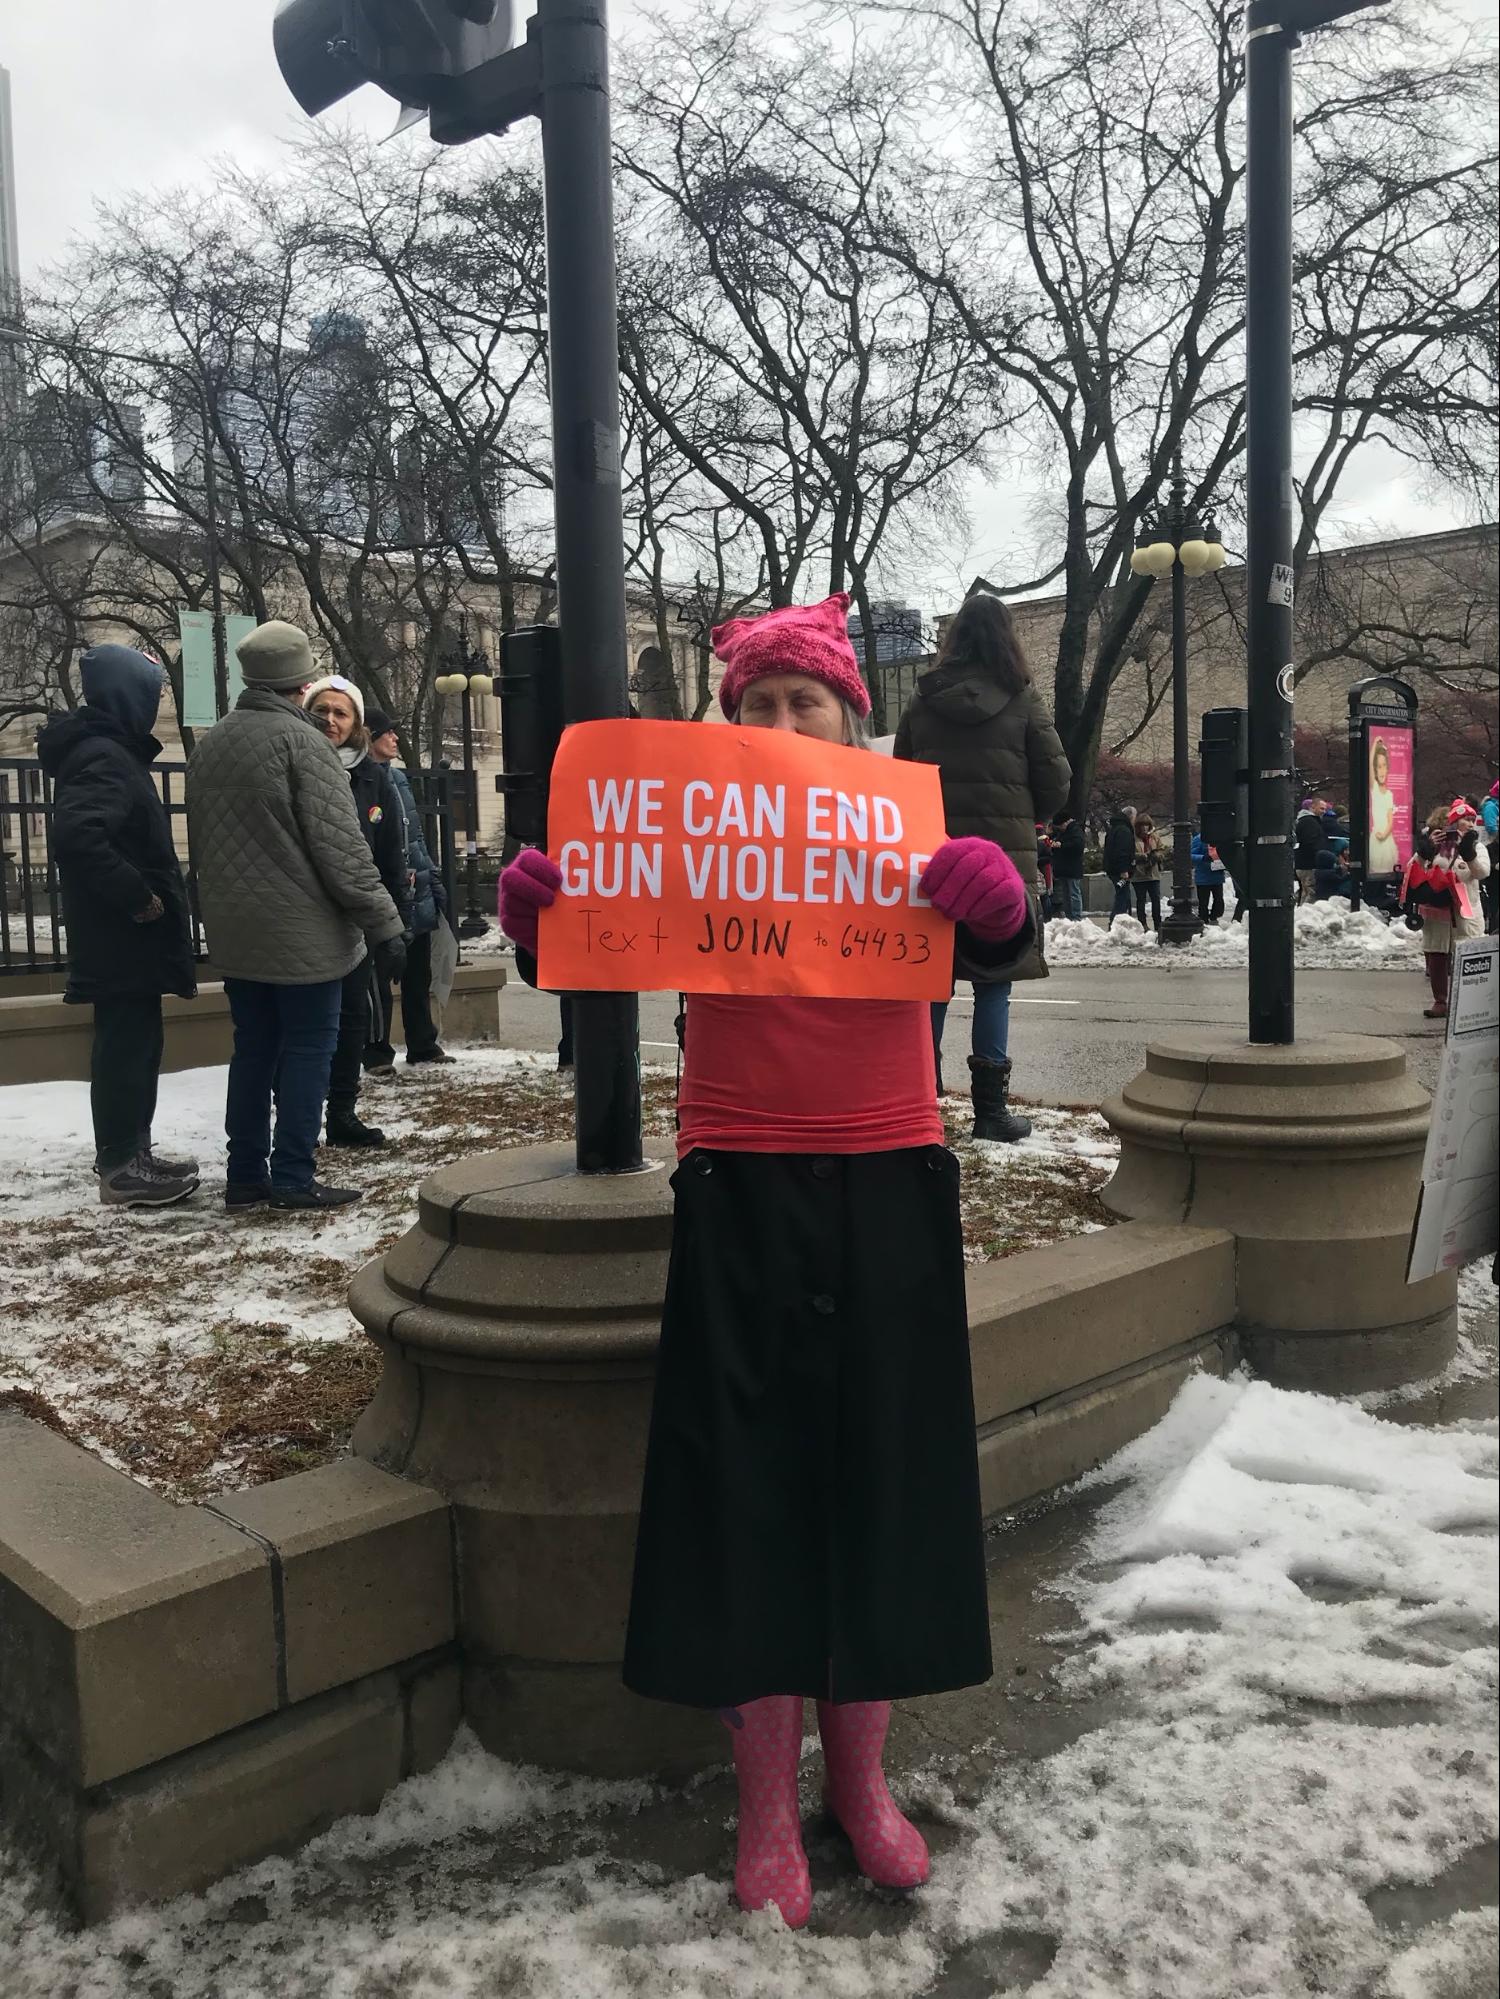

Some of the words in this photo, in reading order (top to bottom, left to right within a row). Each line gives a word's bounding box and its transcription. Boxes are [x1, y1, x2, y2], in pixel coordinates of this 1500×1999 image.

[1365, 705, 1378, 715] CITY
[1378, 706, 1408, 717] INFORMATION
[588, 779, 664, 835] WE
[683, 780, 785, 839] CAN
[807, 787, 903, 843] END
[560, 840, 662, 898] GUN
[682, 844, 933, 907] VIOLENCE
[578, 909, 669, 954] Text
[698, 913, 791, 959] JOIN
[813, 931, 828, 946] to
[841, 924, 931, 964] 64433
[1463, 959, 1490, 974] Scotch
